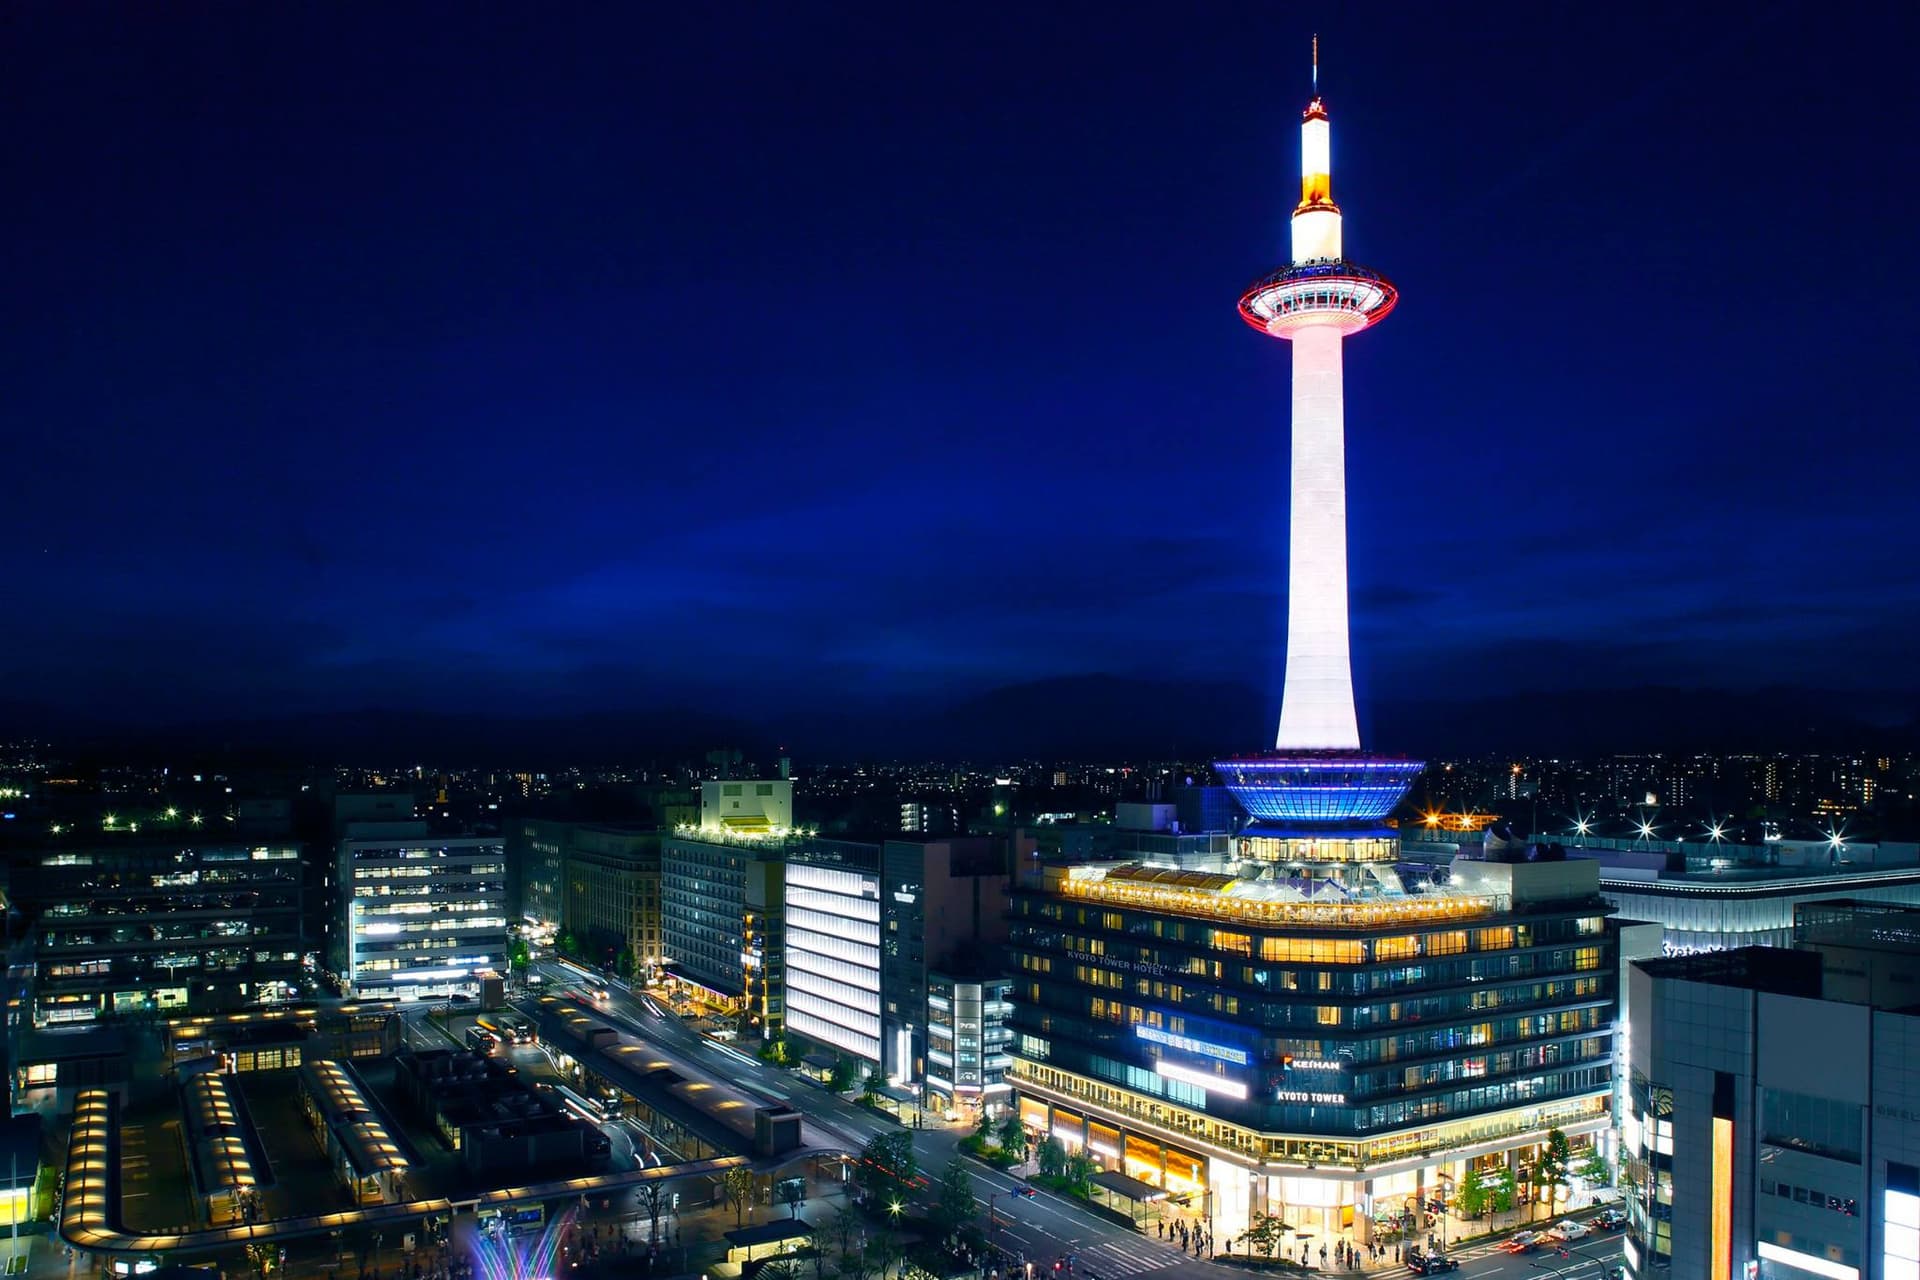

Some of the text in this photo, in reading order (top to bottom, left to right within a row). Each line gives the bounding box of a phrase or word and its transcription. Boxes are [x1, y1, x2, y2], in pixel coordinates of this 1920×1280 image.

[1066, 950, 1165, 976] KYOTO TOWER HOTEL
[1292, 1059, 1340, 1070] KEIHAN
[1278, 1090, 1345, 1103] KYOTO TOWER
